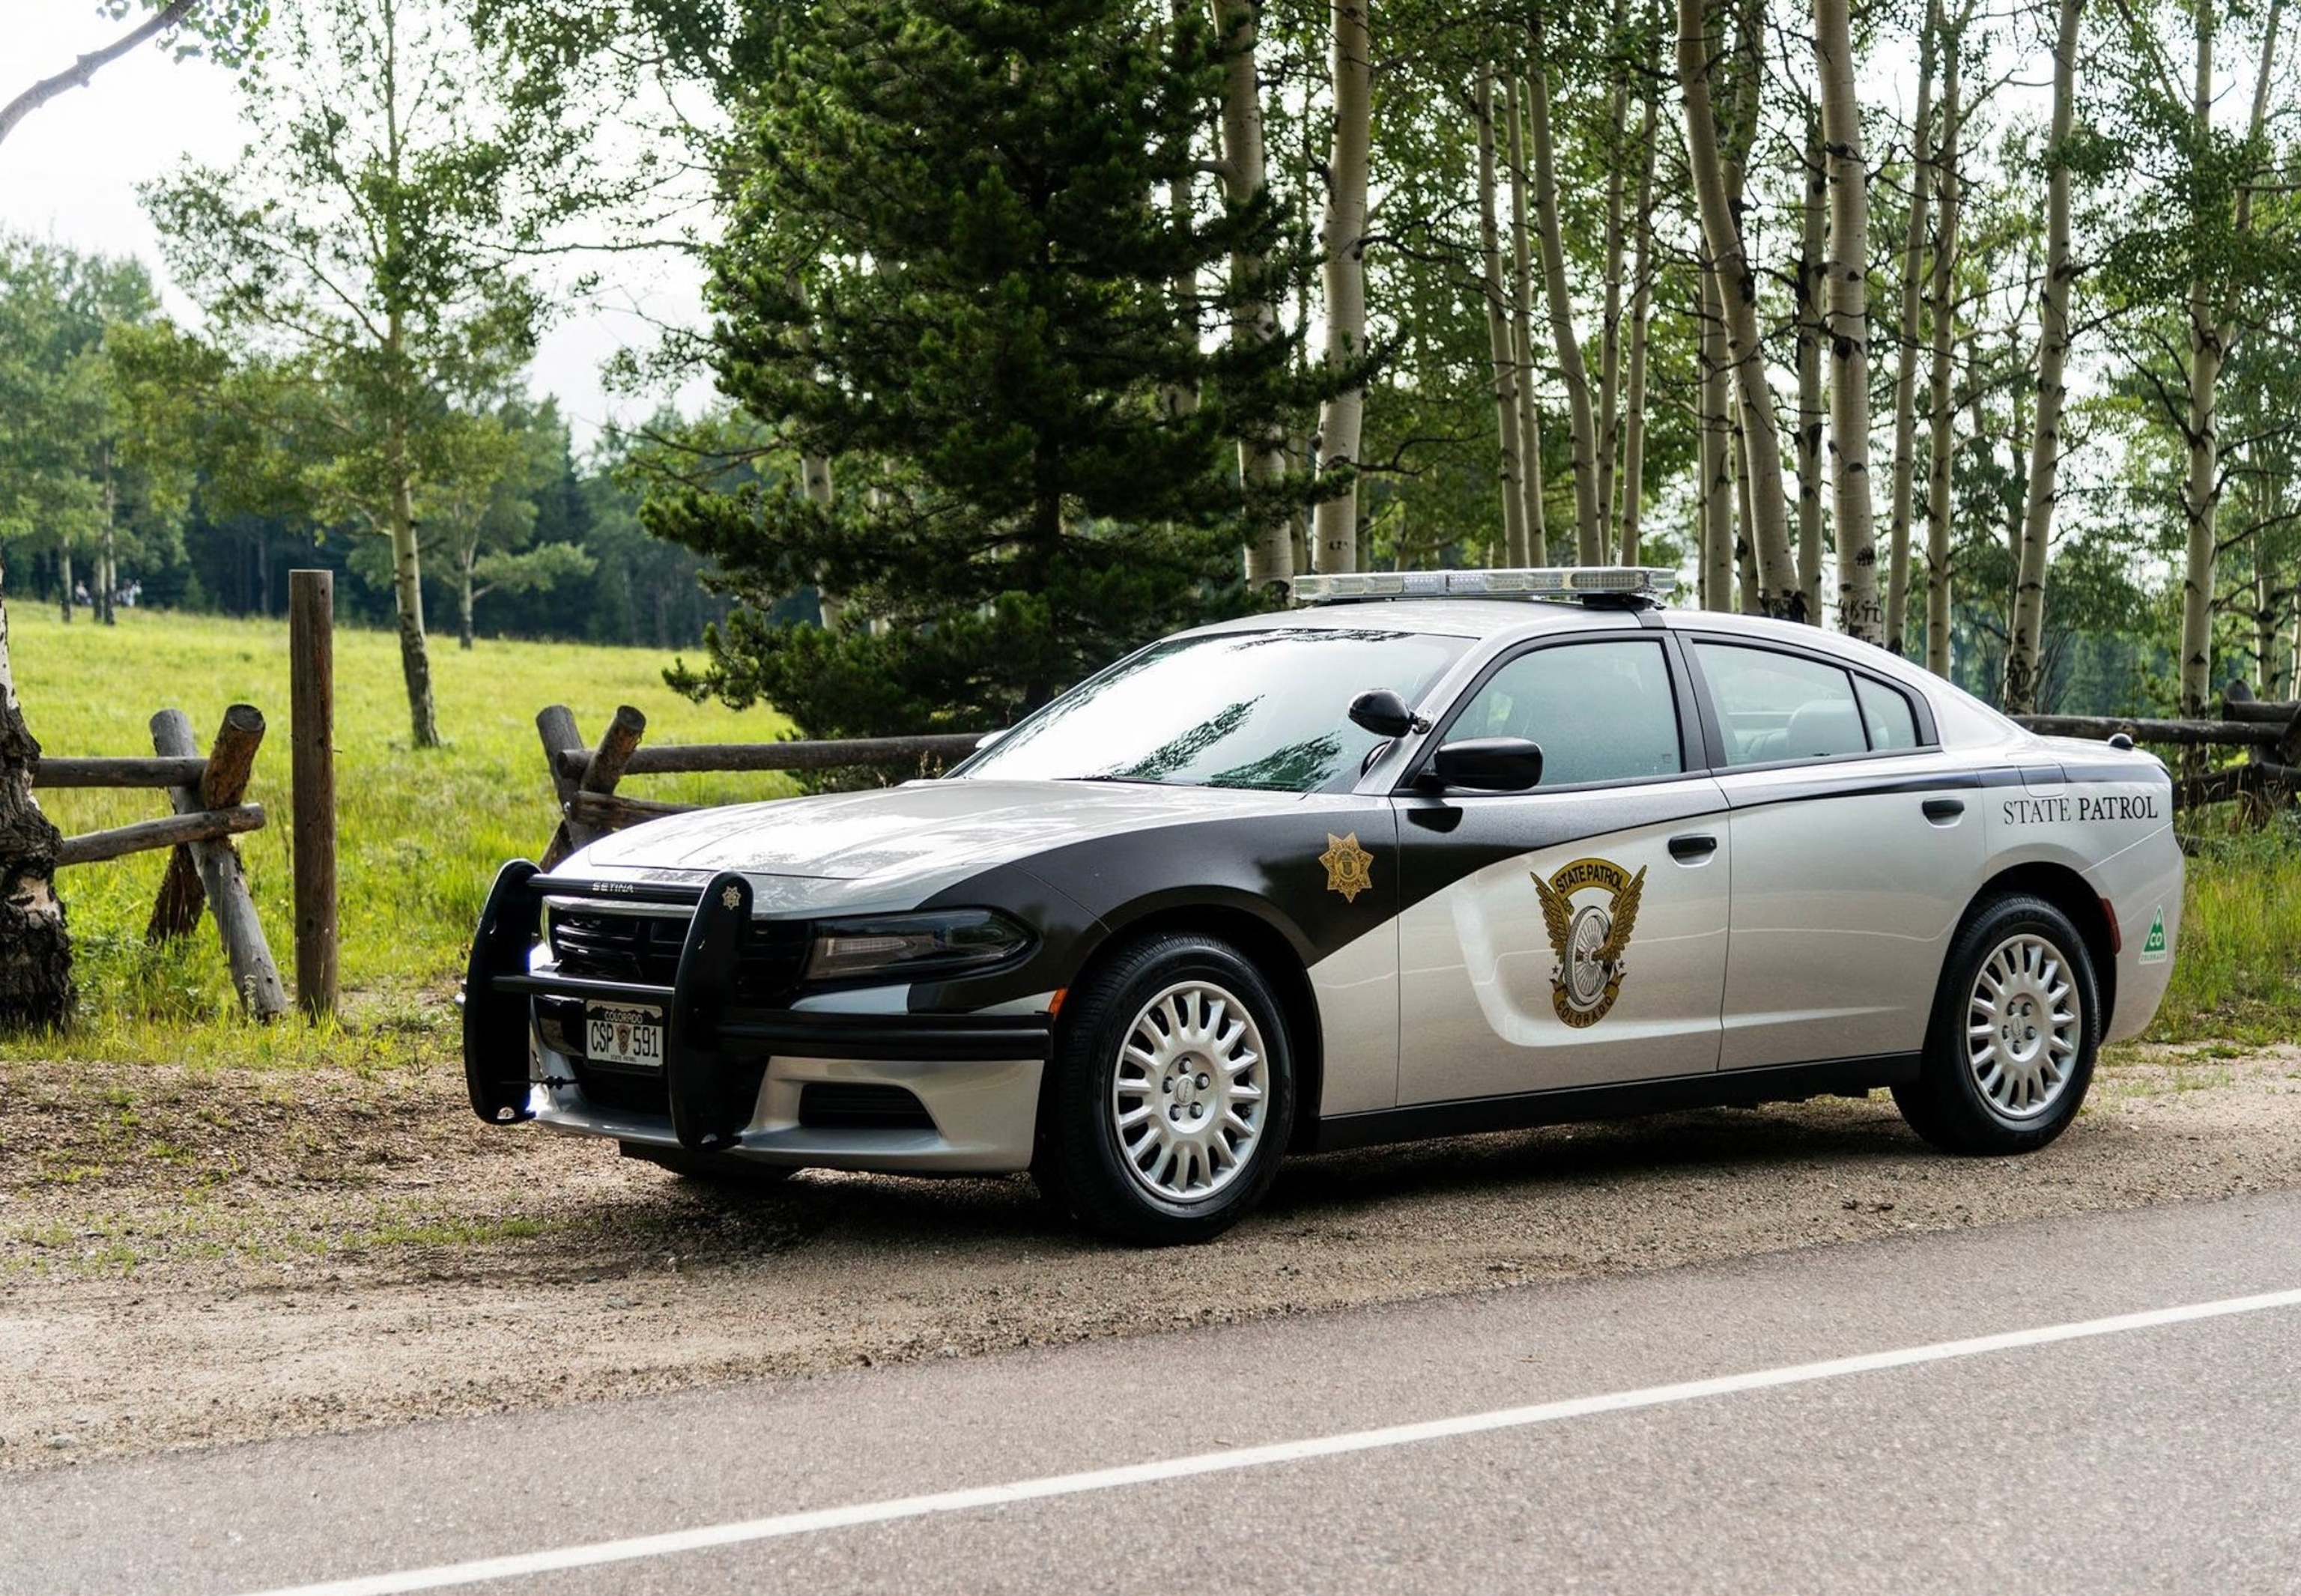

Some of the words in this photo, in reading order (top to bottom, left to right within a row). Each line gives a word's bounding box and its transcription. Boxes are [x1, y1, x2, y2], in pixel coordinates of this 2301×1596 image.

[2004, 798, 2071, 825] STATE
[2079, 796, 2158, 821] PATROL
[592, 882, 634, 893] SETINA
[1555, 864, 1586, 894] STATE
[1586, 864, 1623, 892] PATROL
[2150, 932, 2162, 947] CO
[604, 1011, 643, 1023] COLORADO
[1557, 997, 1612, 1026] COLORADO
[591, 1021, 614, 1053] CSP
[633, 1025, 659, 1058] 591
